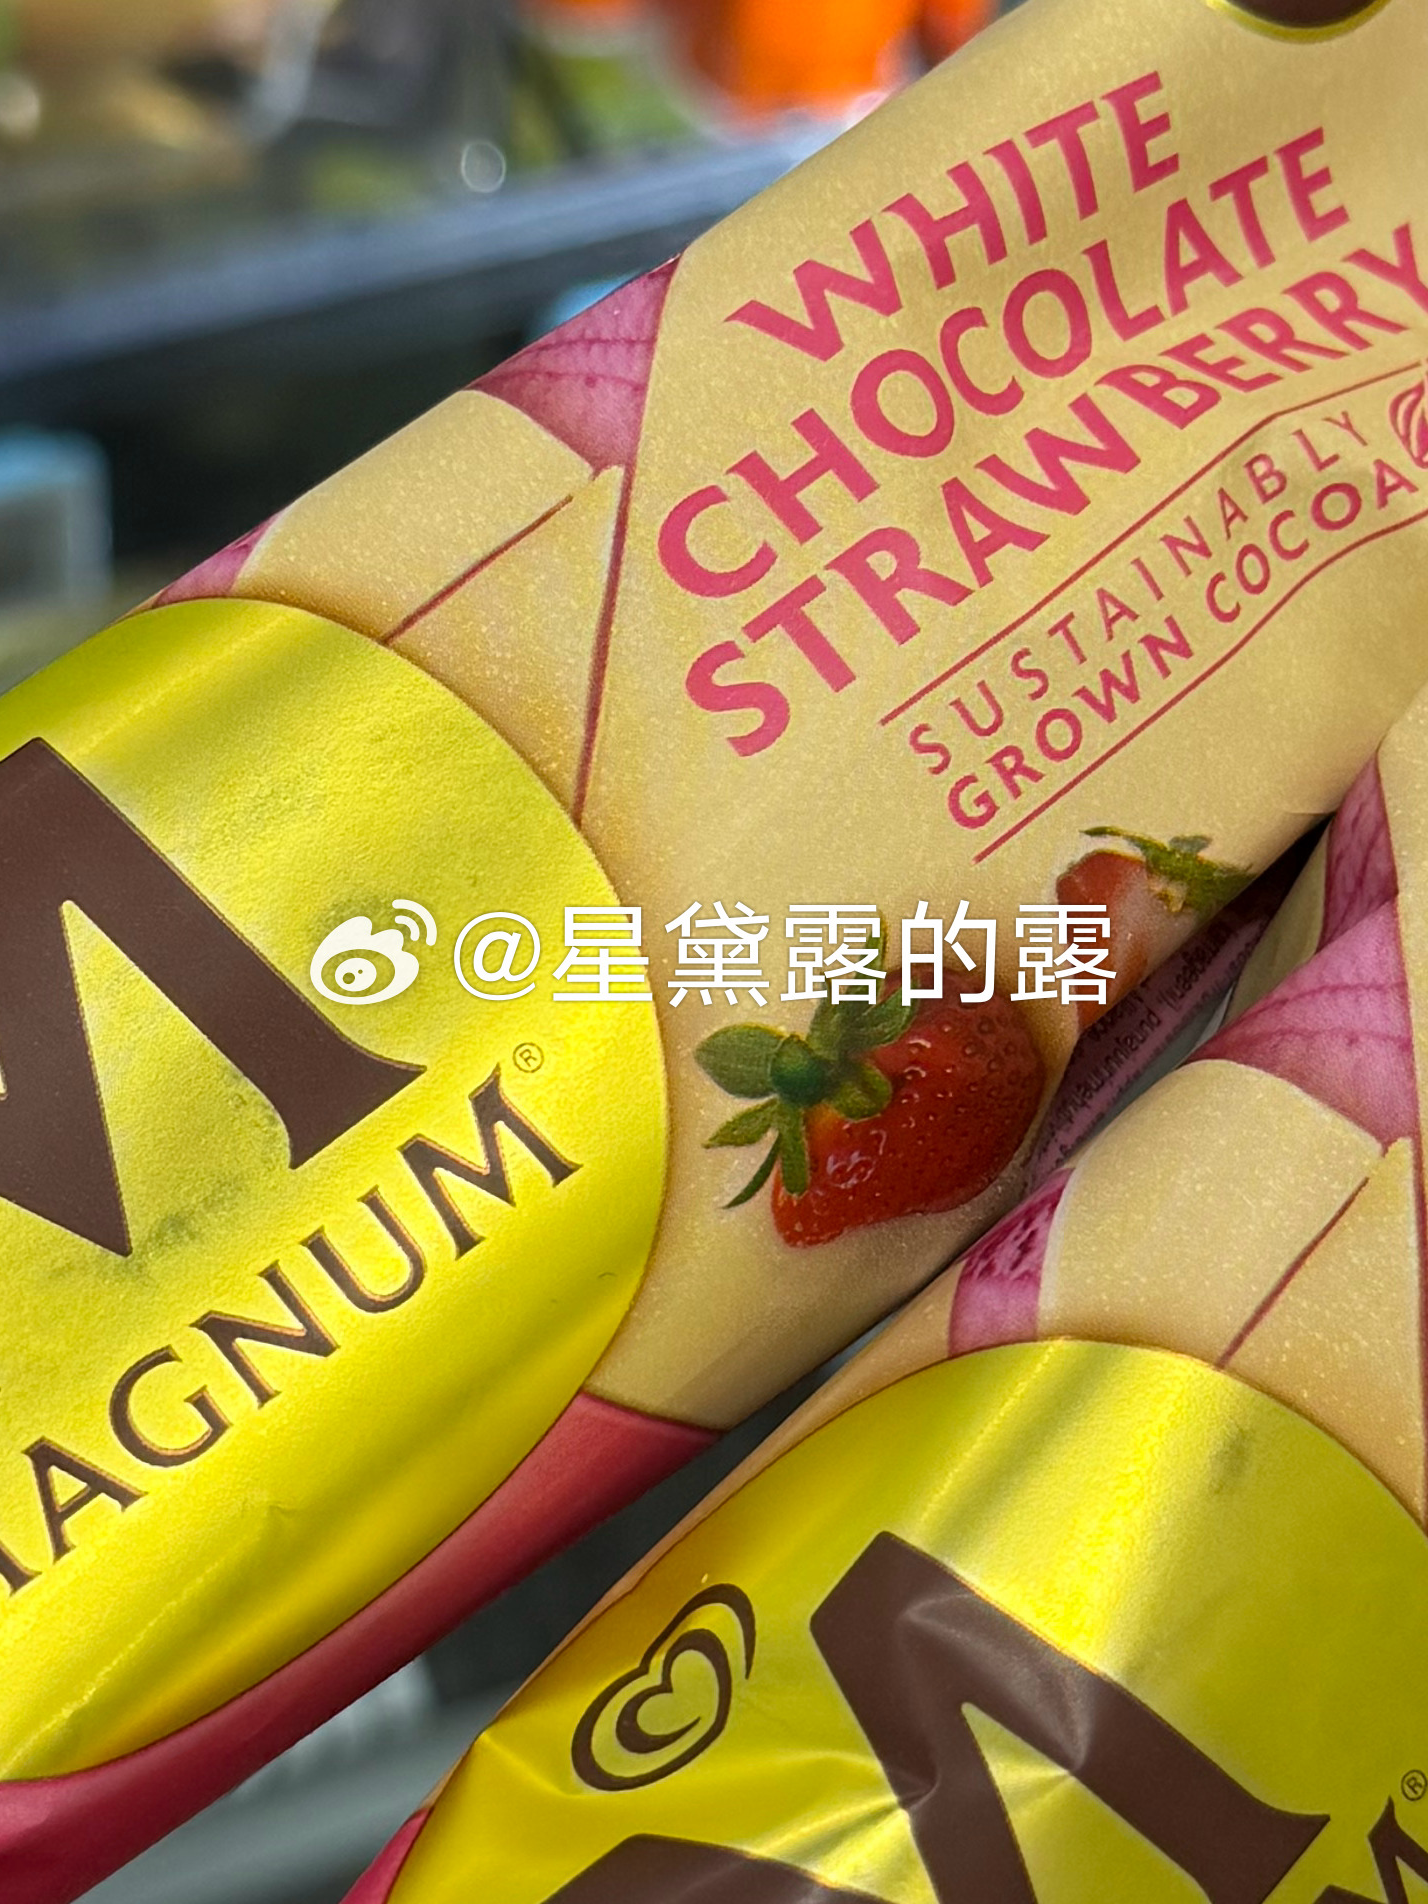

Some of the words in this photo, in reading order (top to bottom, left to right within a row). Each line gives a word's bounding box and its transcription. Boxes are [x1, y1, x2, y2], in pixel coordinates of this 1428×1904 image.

[656, 127, 1352, 598] CHOCOLATE
[725, 71, 1180, 364] WHITE
[908, 408, 1370, 776] SUSTAINABLY
[947, 614, 1194, 831] GROWN
[1205, 459, 1418, 624] COCOA
